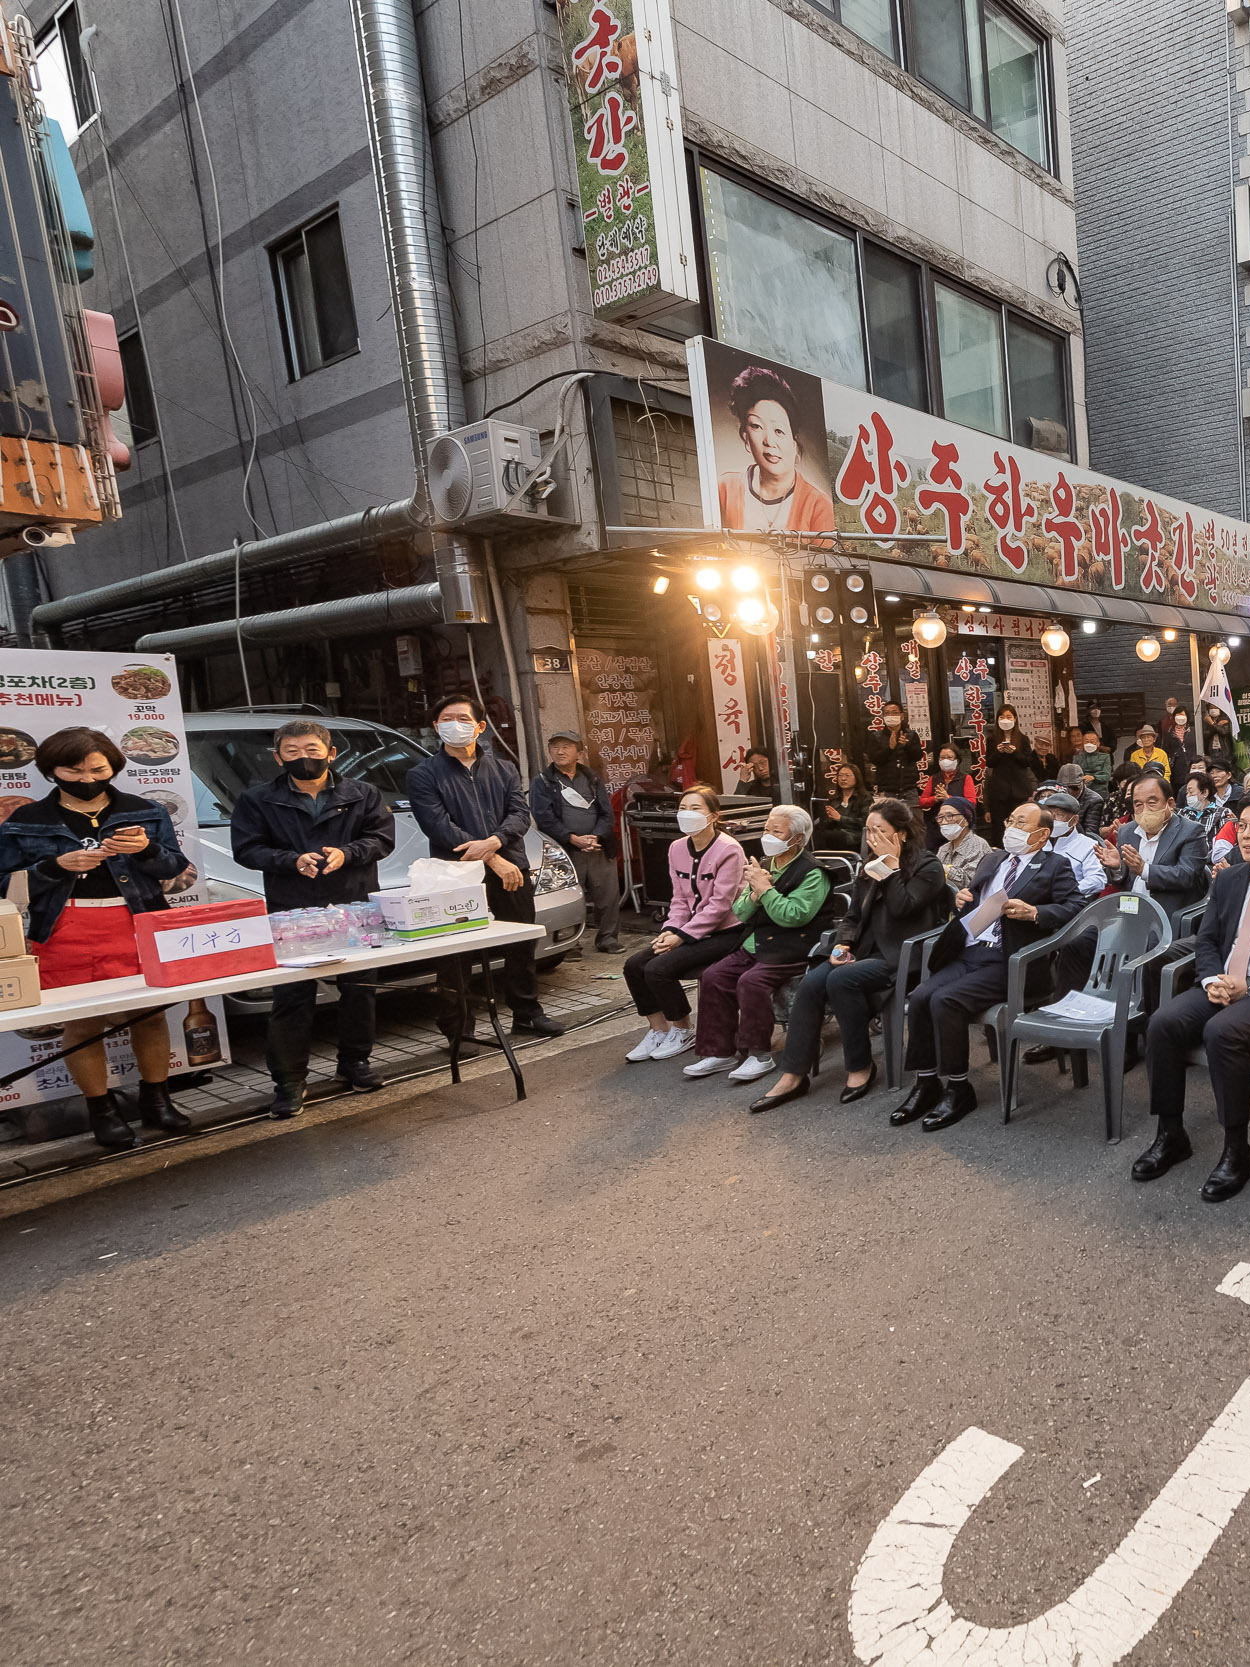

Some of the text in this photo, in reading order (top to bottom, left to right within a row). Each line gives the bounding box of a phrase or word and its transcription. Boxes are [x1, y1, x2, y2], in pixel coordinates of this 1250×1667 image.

[463, 431, 488, 445] SAMSUNG
[544, 658, 561, 668] 38
[955, 657, 989, 681] 상주
[134, 705, 156, 713] 꼬막
[127, 713, 166, 721] 19.000
[588, 710, 652, 726] 생고기모듬
[588, 727, 615, 743] 육회
[628, 727, 654, 741] 목살
[599, 745, 650, 761] 육사시미
[137, 776, 175, 785] 12.000
